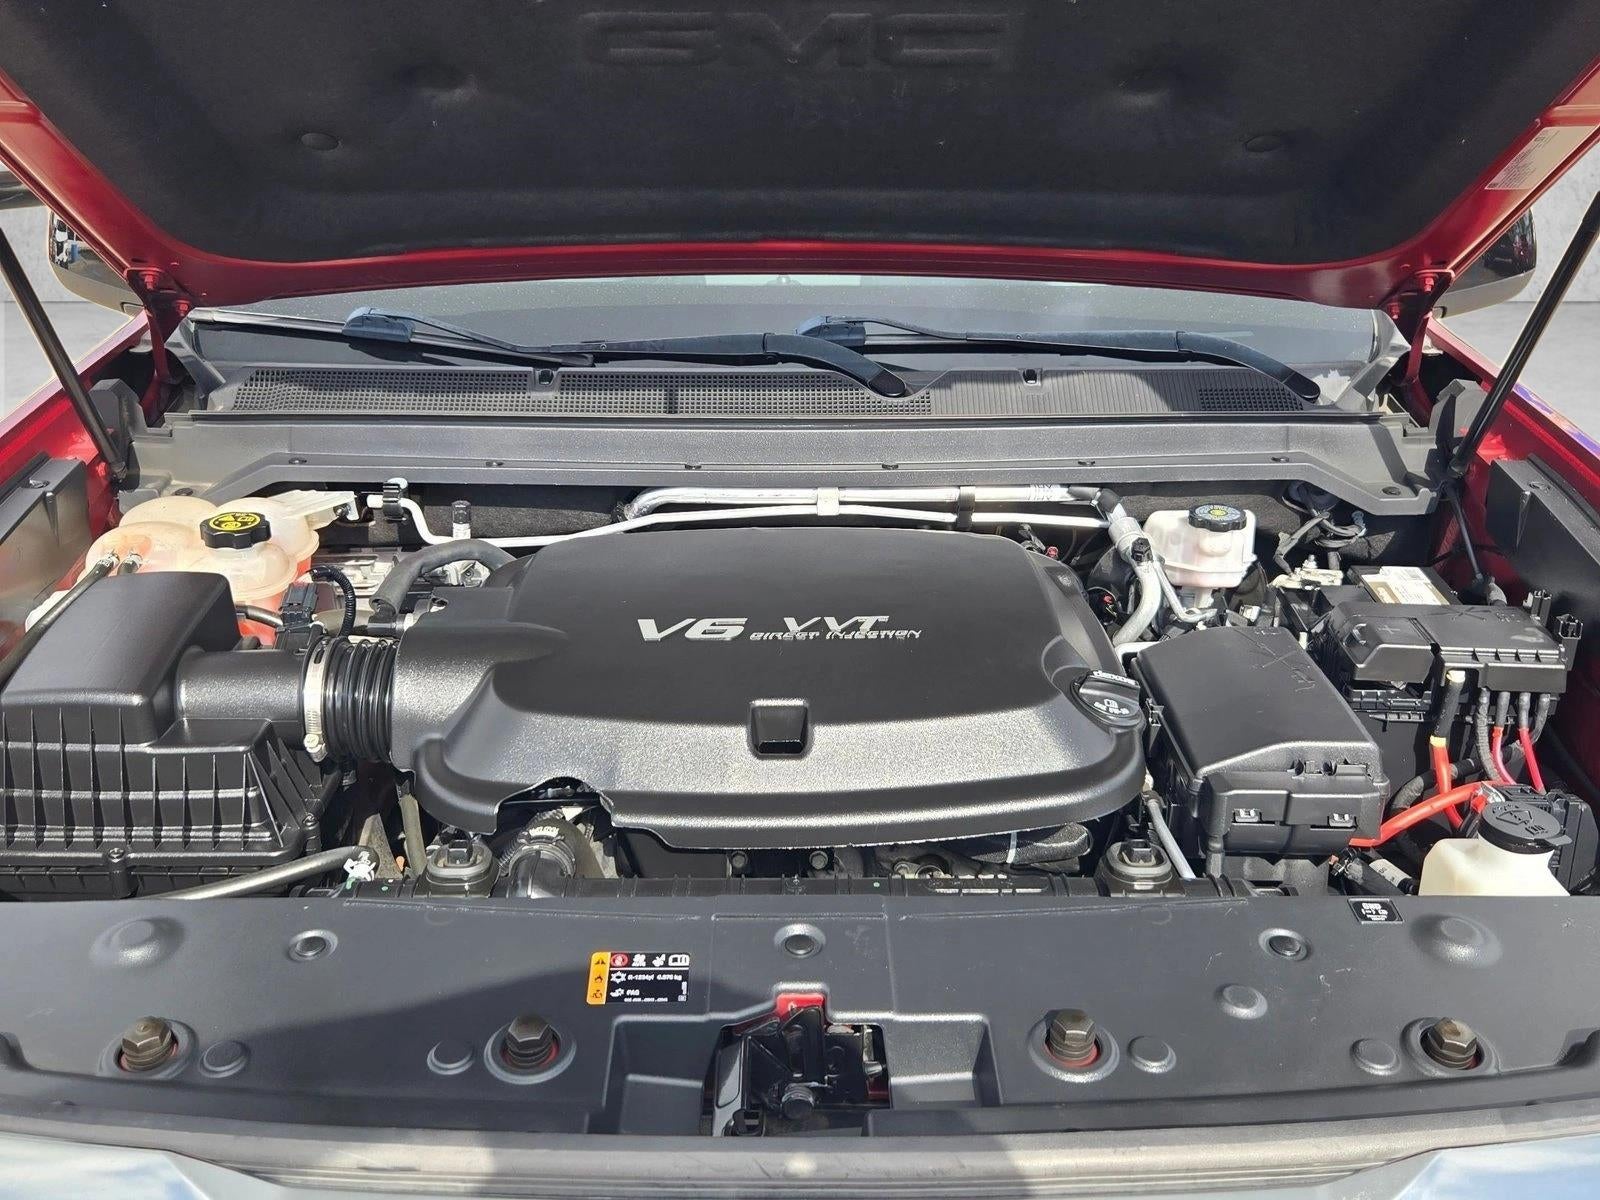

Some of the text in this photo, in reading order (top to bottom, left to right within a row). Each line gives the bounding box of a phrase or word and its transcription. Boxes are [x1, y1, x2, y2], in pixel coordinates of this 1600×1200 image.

[577, 11, 1008, 66] GMC
[637, 615, 890, 642] V6 VVT
